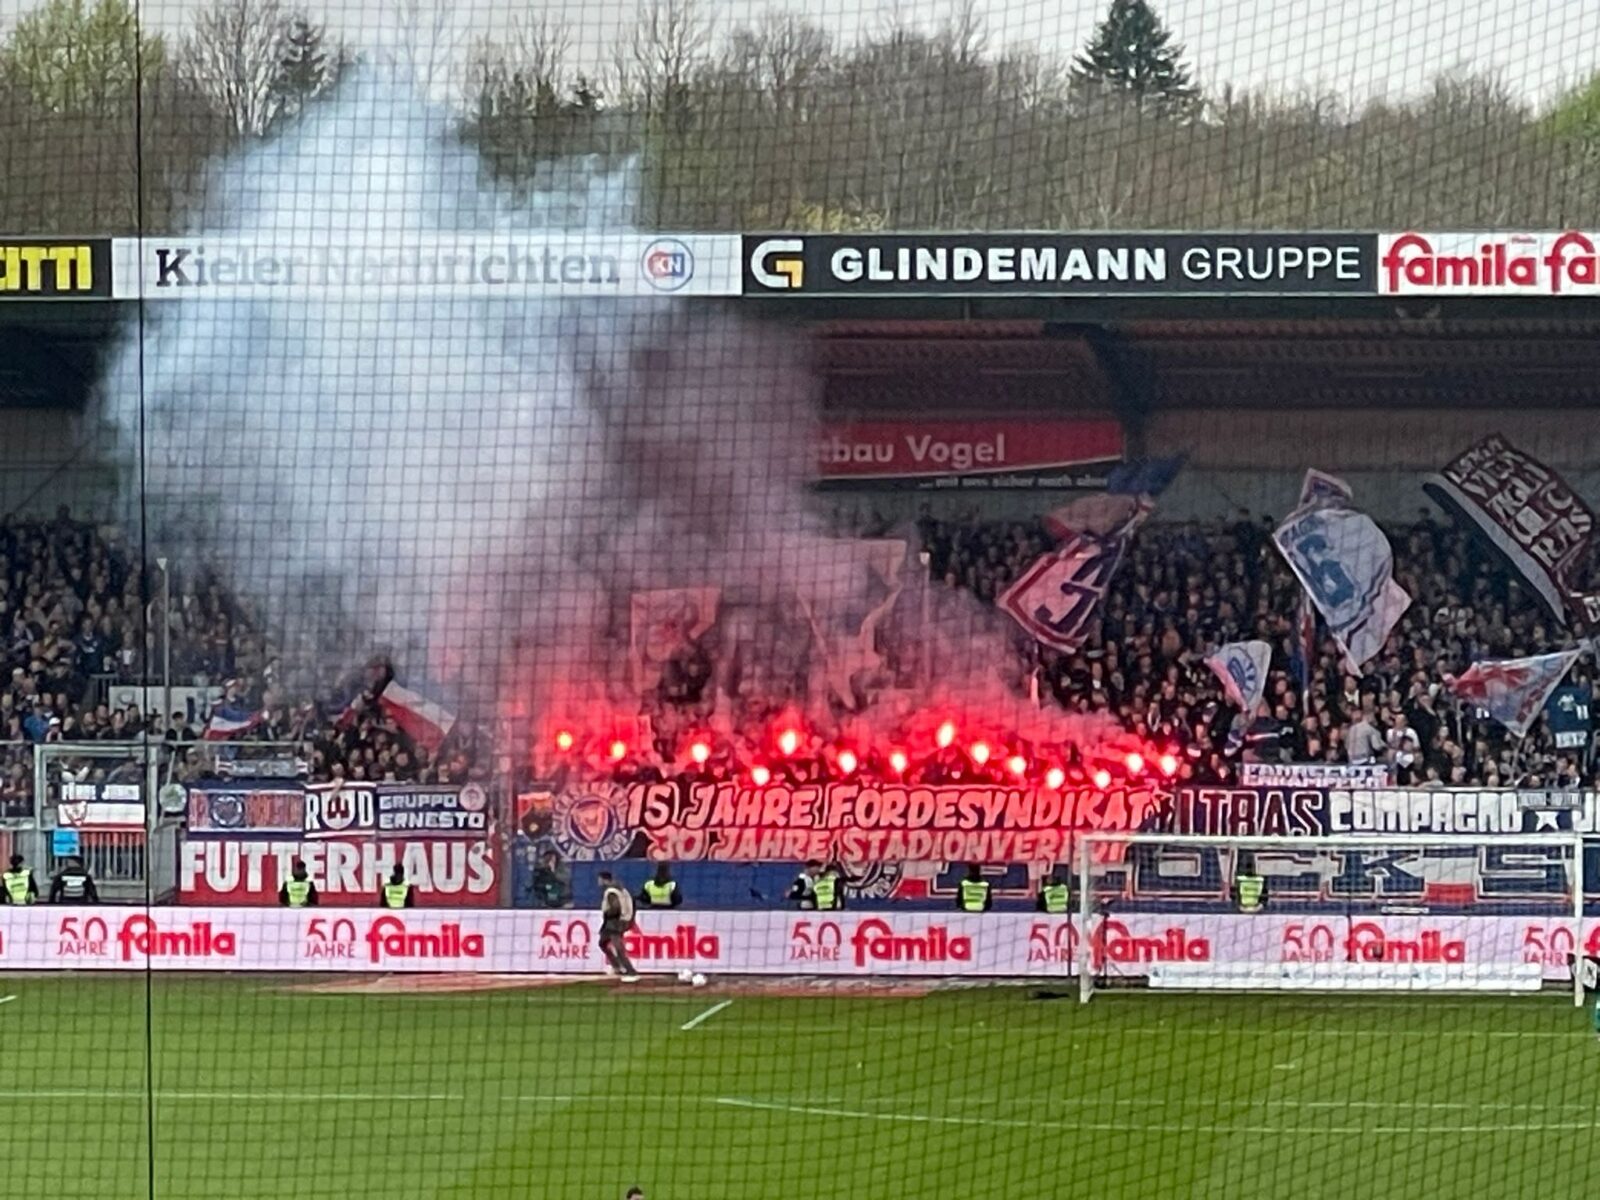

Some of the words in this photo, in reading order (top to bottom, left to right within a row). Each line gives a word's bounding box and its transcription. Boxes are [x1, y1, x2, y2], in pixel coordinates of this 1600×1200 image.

[155, 249, 301, 287] Kieler
[831, 247, 1166, 281] GLINDEMANN
[1181, 246, 1361, 280] GRUPPE
[1382, 234, 1537, 292] famila
[1544, 232, 1600, 292] fa
[905, 433, 1005, 469] Vogel
[379, 793, 458, 811] GRUPPO
[627, 784, 672, 829] 15
[687, 784, 817, 828] JAHRE
[828, 783, 1152, 831] FÖRDESYNDIKAT
[379, 811, 485, 829] ERNESTO
[713, 828, 830, 860] JAHRE
[181, 841, 494, 894] FUTTERHAUS
[60, 917, 108, 942] 50
[117, 914, 236, 961] famila
[307, 919, 356, 941] 50
[366, 916, 485, 963] famila
[541, 920, 591, 943] 50
[605, 924, 719, 961] amila
[792, 922, 841, 946] 50
[852, 919, 972, 967] famila
[1029, 924, 1079, 947] 50
[1089, 920, 1210, 971] famila
[1283, 925, 1334, 951] 50
[1344, 922, 1466, 963] famila
[1524, 927, 1574, 951] 50
[57, 941, 108, 955] JAHRE
[304, 942, 356, 958] JAHRE
[538, 944, 590, 959] JAHRE
[790, 945, 841, 960] JAHRE
